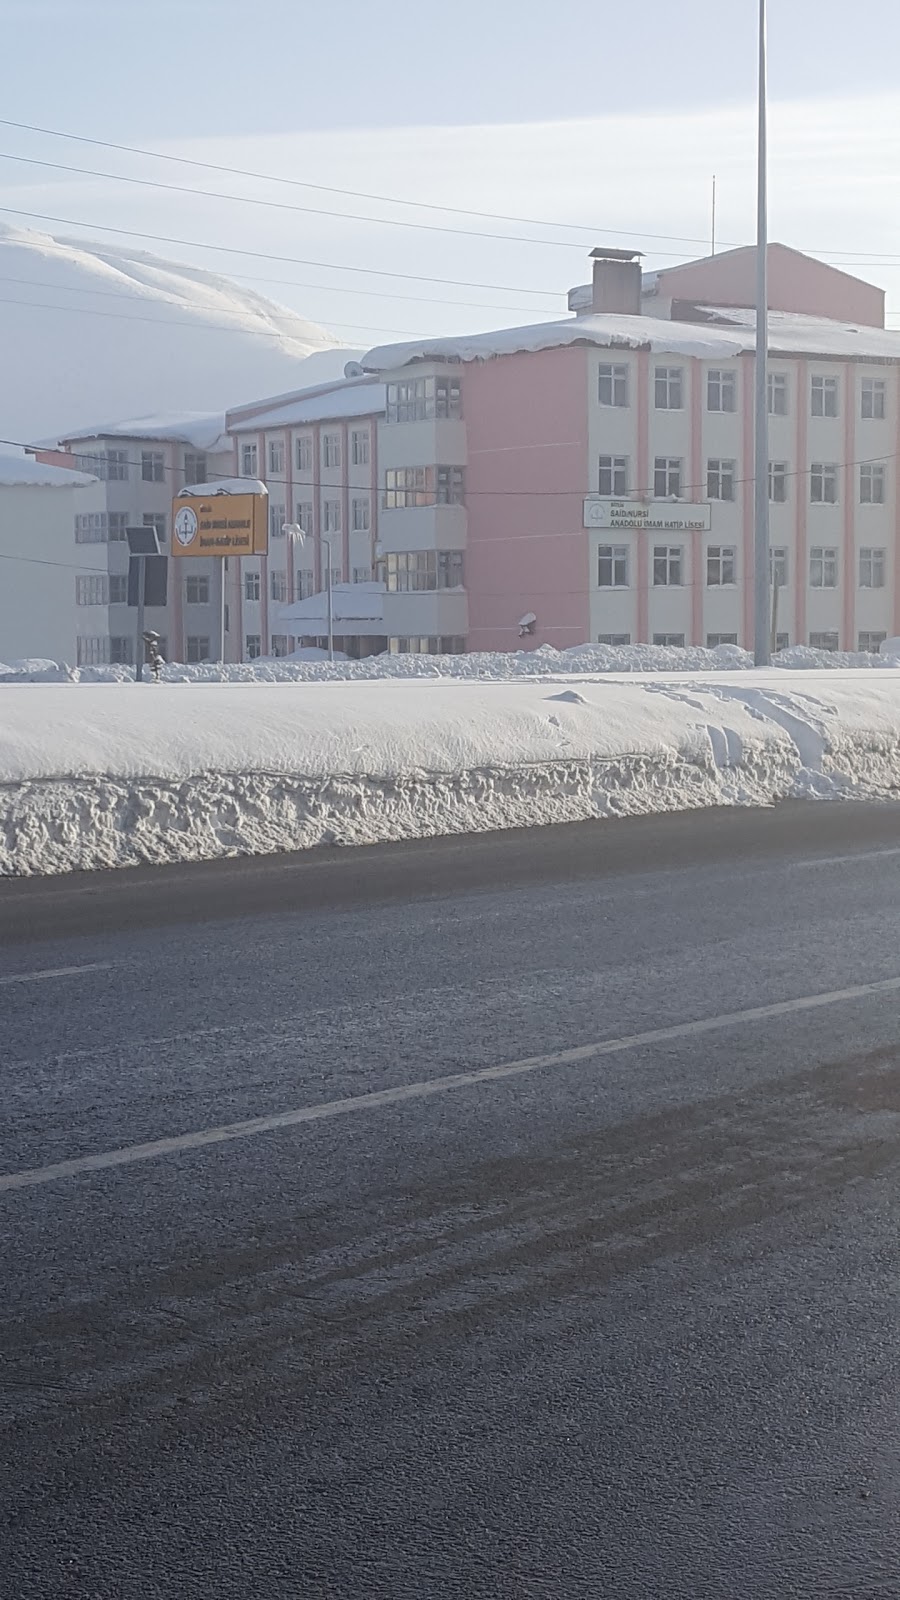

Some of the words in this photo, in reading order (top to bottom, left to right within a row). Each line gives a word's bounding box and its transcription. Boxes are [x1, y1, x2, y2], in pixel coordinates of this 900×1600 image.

[611, 519, 642, 527] ANADOLU
[644, 518, 663, 528] İMAM
[685, 520, 704, 529] LİSESİ
